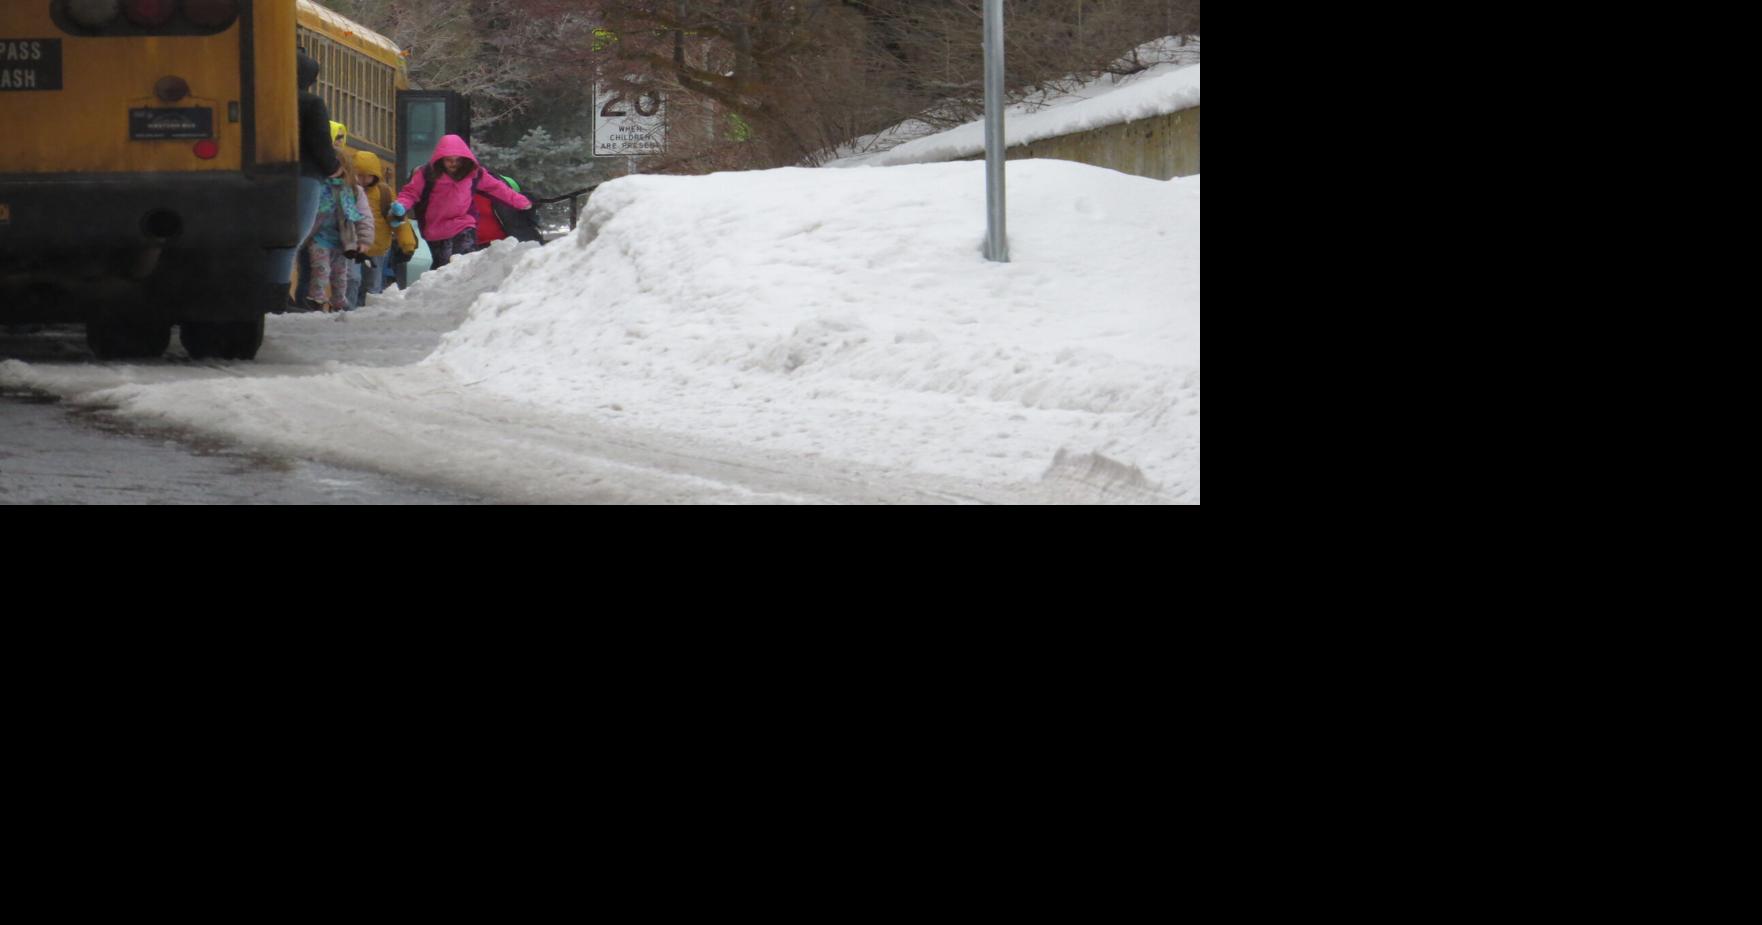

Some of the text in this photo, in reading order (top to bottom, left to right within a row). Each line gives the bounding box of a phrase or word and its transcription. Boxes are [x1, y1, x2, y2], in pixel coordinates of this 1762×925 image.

[0, 41, 40, 60] PASS
[1, 69, 35, 88] ASH
[600, 88, 660, 117] 20
